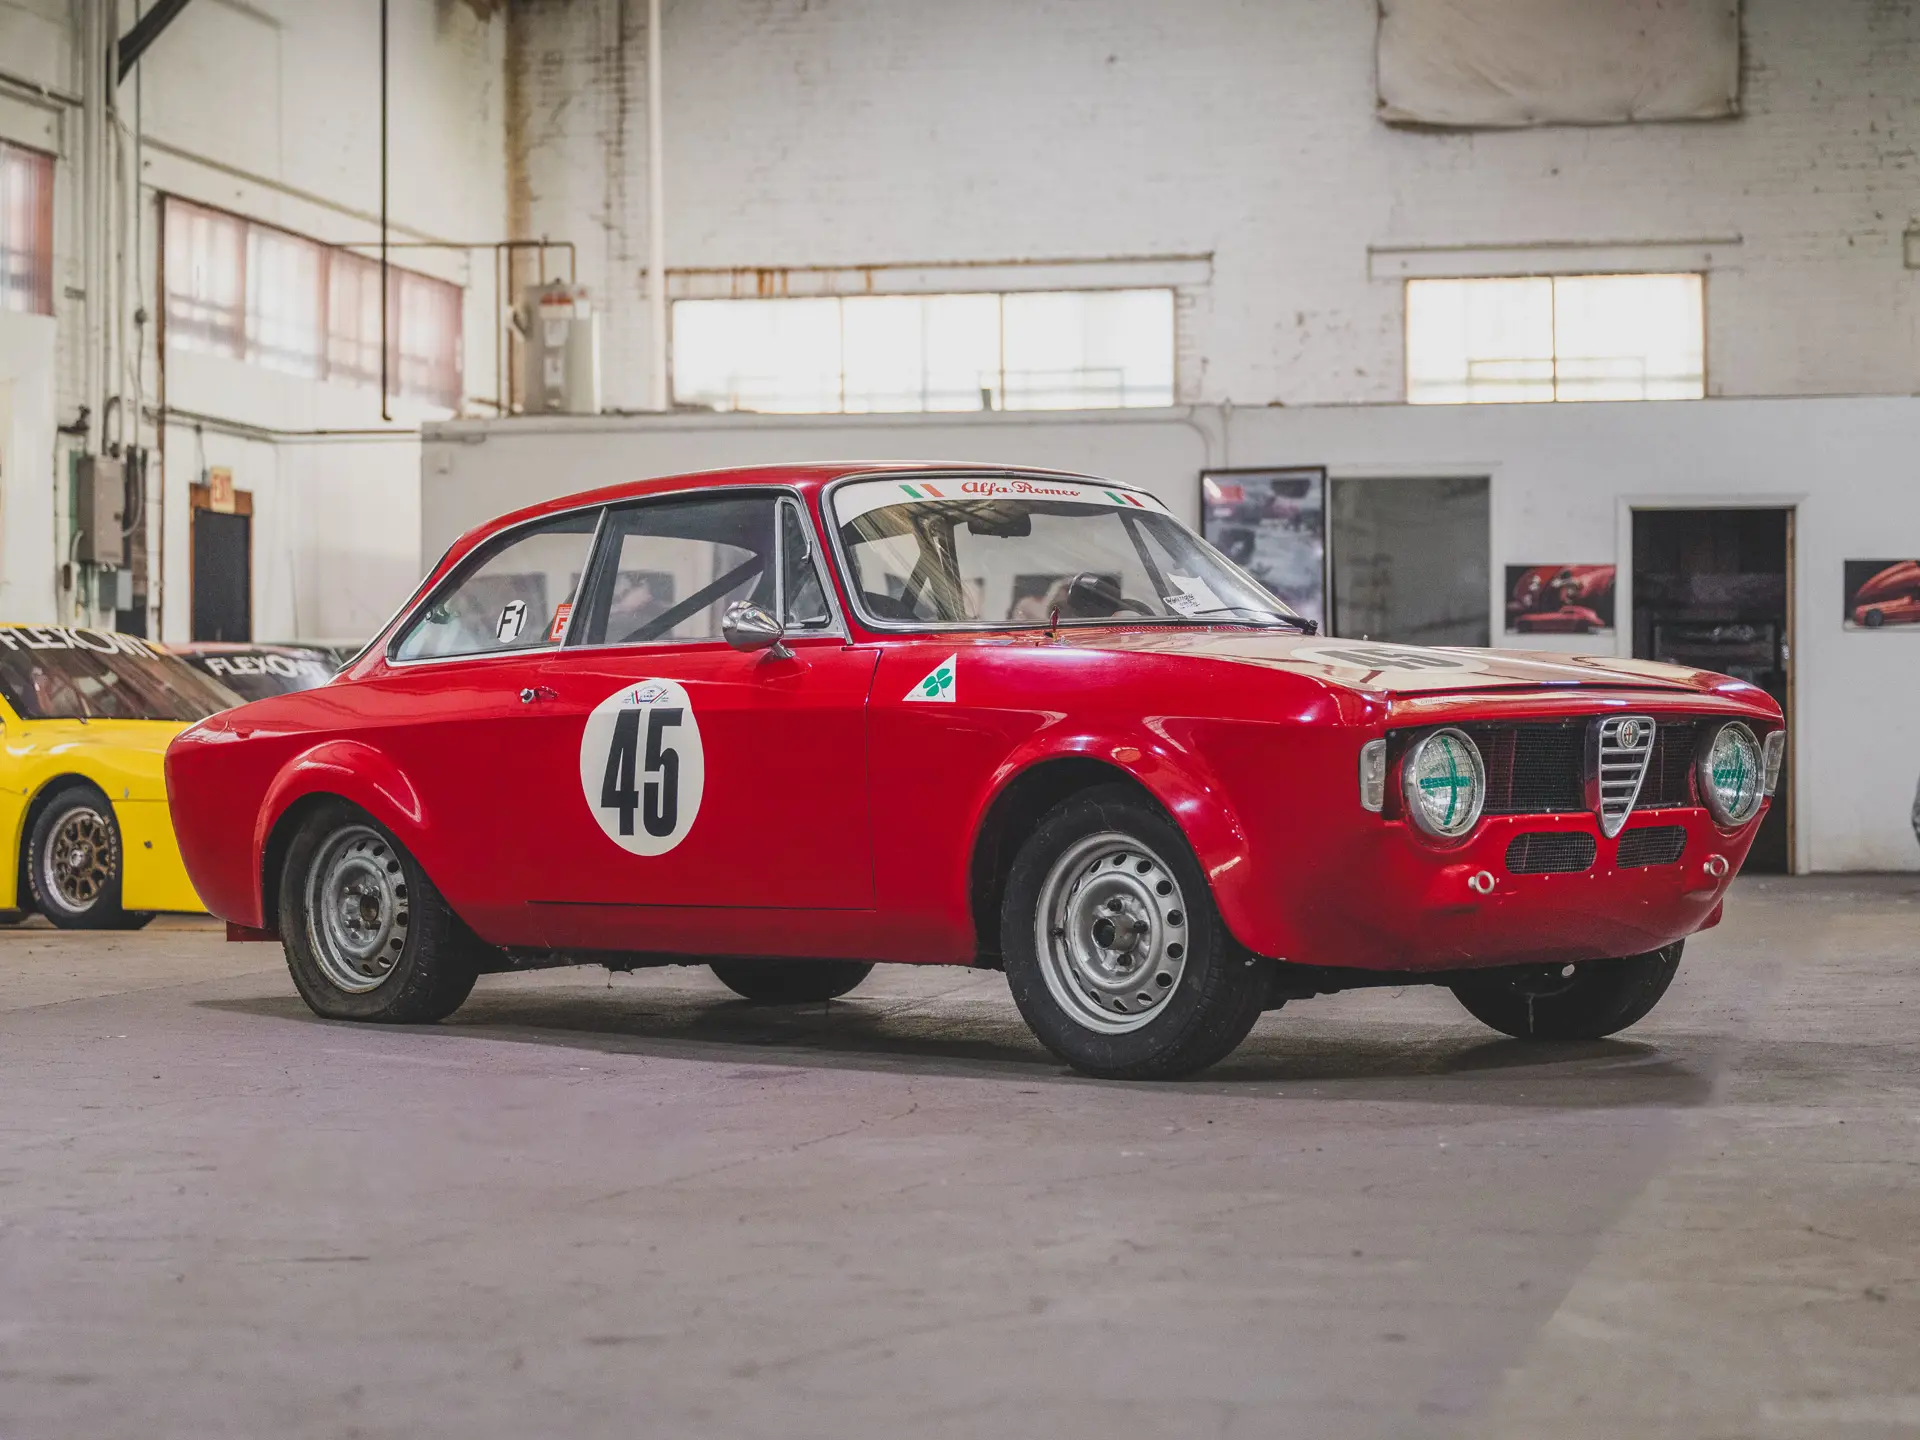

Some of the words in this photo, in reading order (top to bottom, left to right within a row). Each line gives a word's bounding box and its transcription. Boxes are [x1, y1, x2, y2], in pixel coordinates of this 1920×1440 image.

[961, 482, 1012, 496] Alfa
[1012, 481, 1080, 496] Romeo
[497, 604, 526, 638] F1
[1315, 649, 1463, 670] 45
[601, 708, 684, 837] 45
